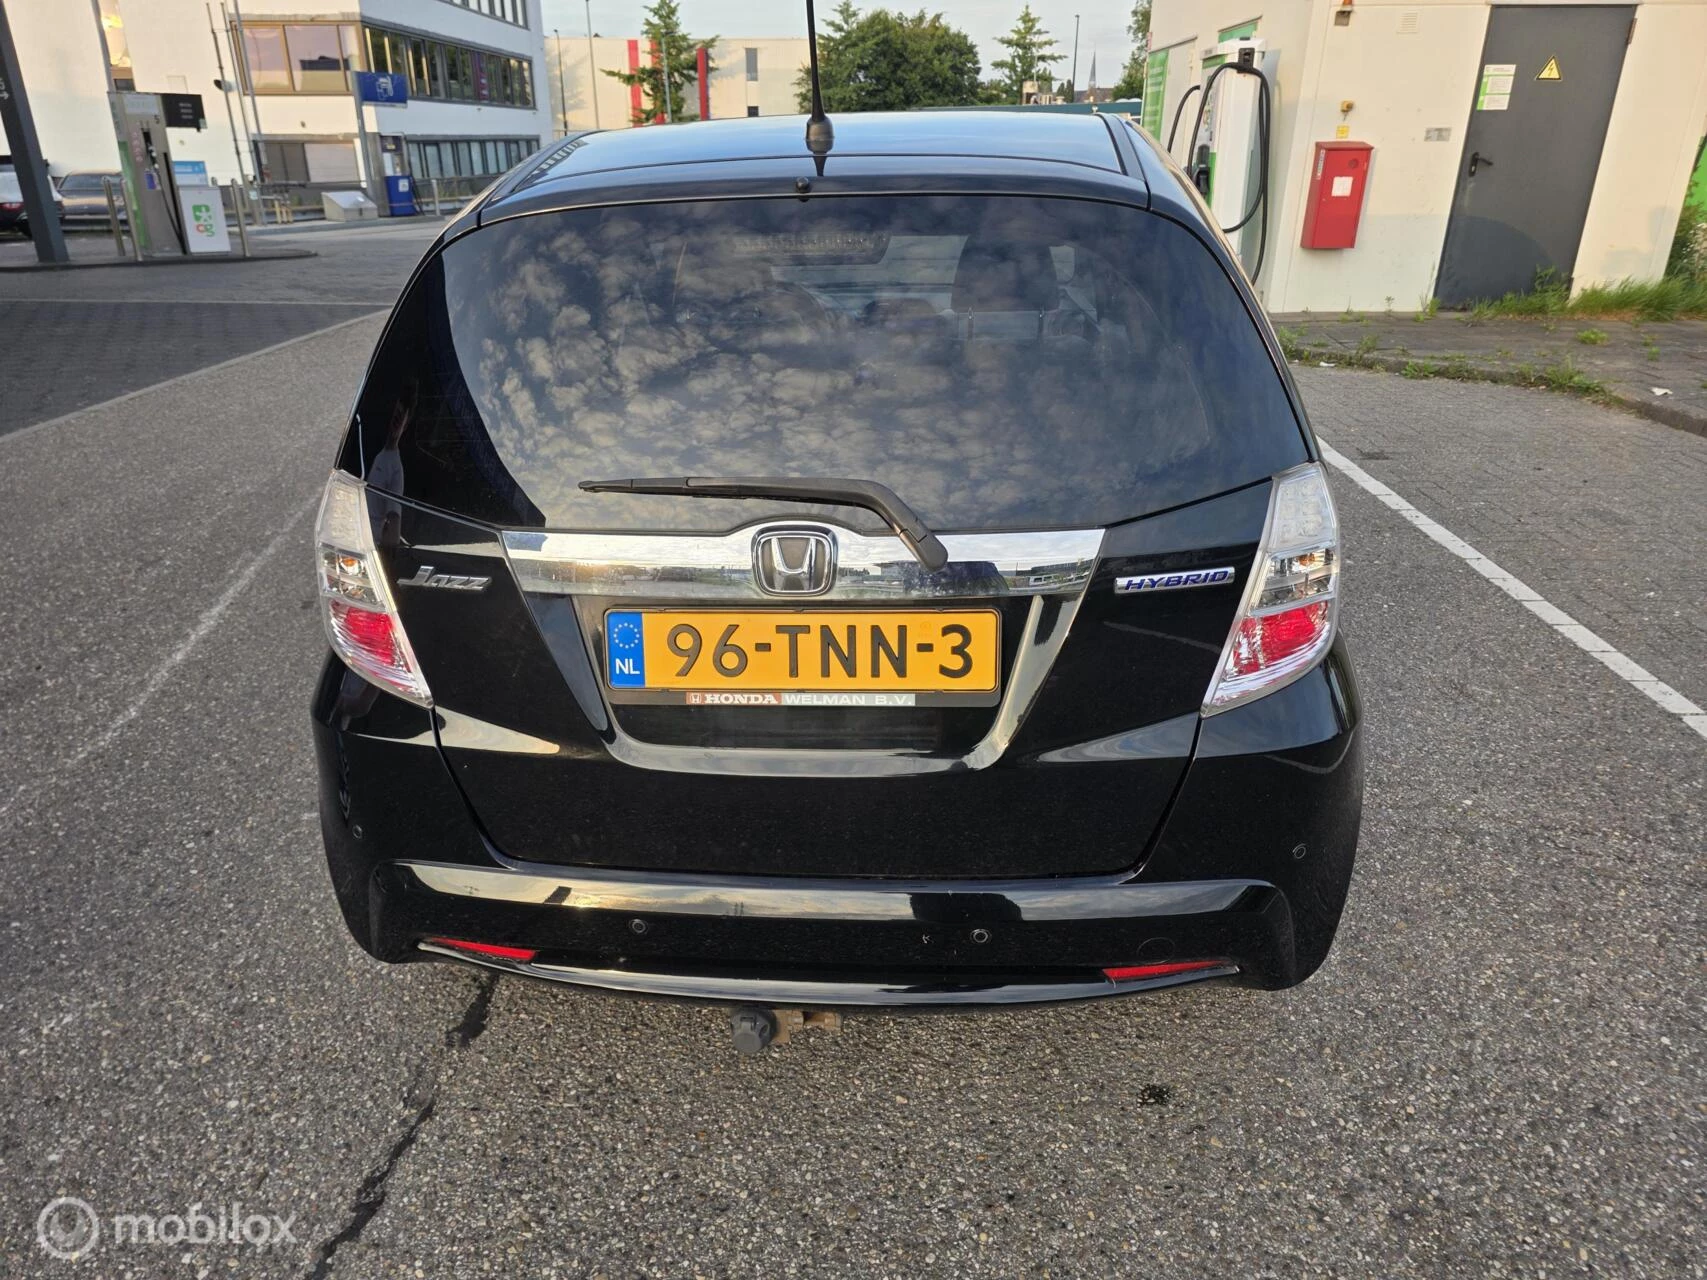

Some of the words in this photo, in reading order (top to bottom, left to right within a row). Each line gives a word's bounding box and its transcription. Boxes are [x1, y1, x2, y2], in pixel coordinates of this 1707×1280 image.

[396, 565, 490, 591] Jazz
[1124, 570, 1230, 591] HYBRID
[666, 623, 974, 679] 96-TNN-3
[615, 658, 641, 675] NL
[704, 692, 779, 705] HONDA
[784, 694, 866, 706] WELMAN
[874, 694, 914, 706] B.V.
